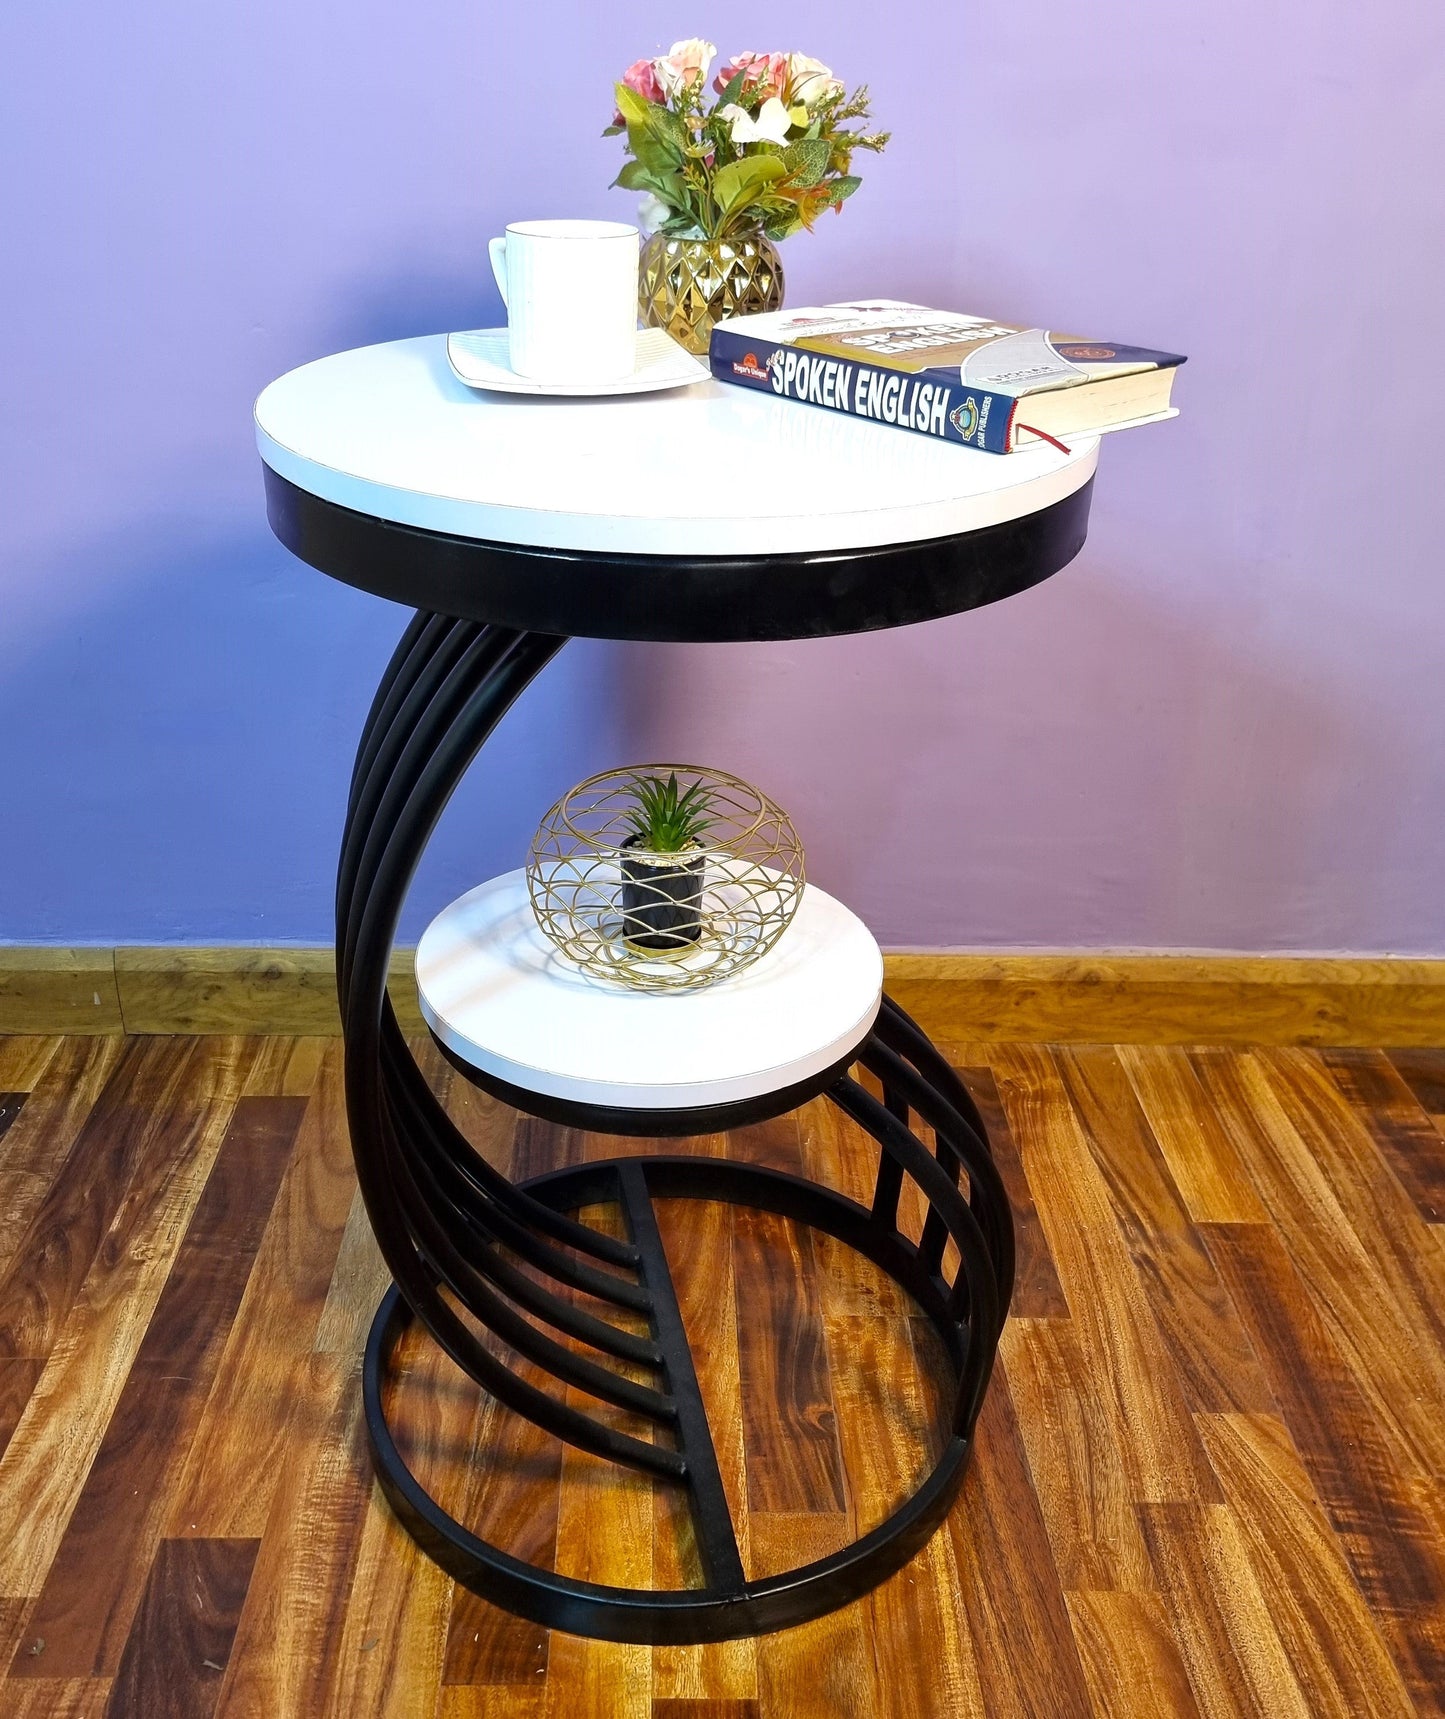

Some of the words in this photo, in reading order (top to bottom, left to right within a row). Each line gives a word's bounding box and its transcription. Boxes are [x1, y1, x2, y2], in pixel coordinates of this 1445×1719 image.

[841, 321, 984, 347] SPOKEN
[865, 325, 1020, 354] ENGLISH
[751, 367, 767, 379] Unique
[772, 349, 853, 411] SPOKEN
[855, 368, 951, 437] ENGLISH
[977, 395, 993, 432] PUBLISHERS
[977, 431, 986, 449] OGAR
